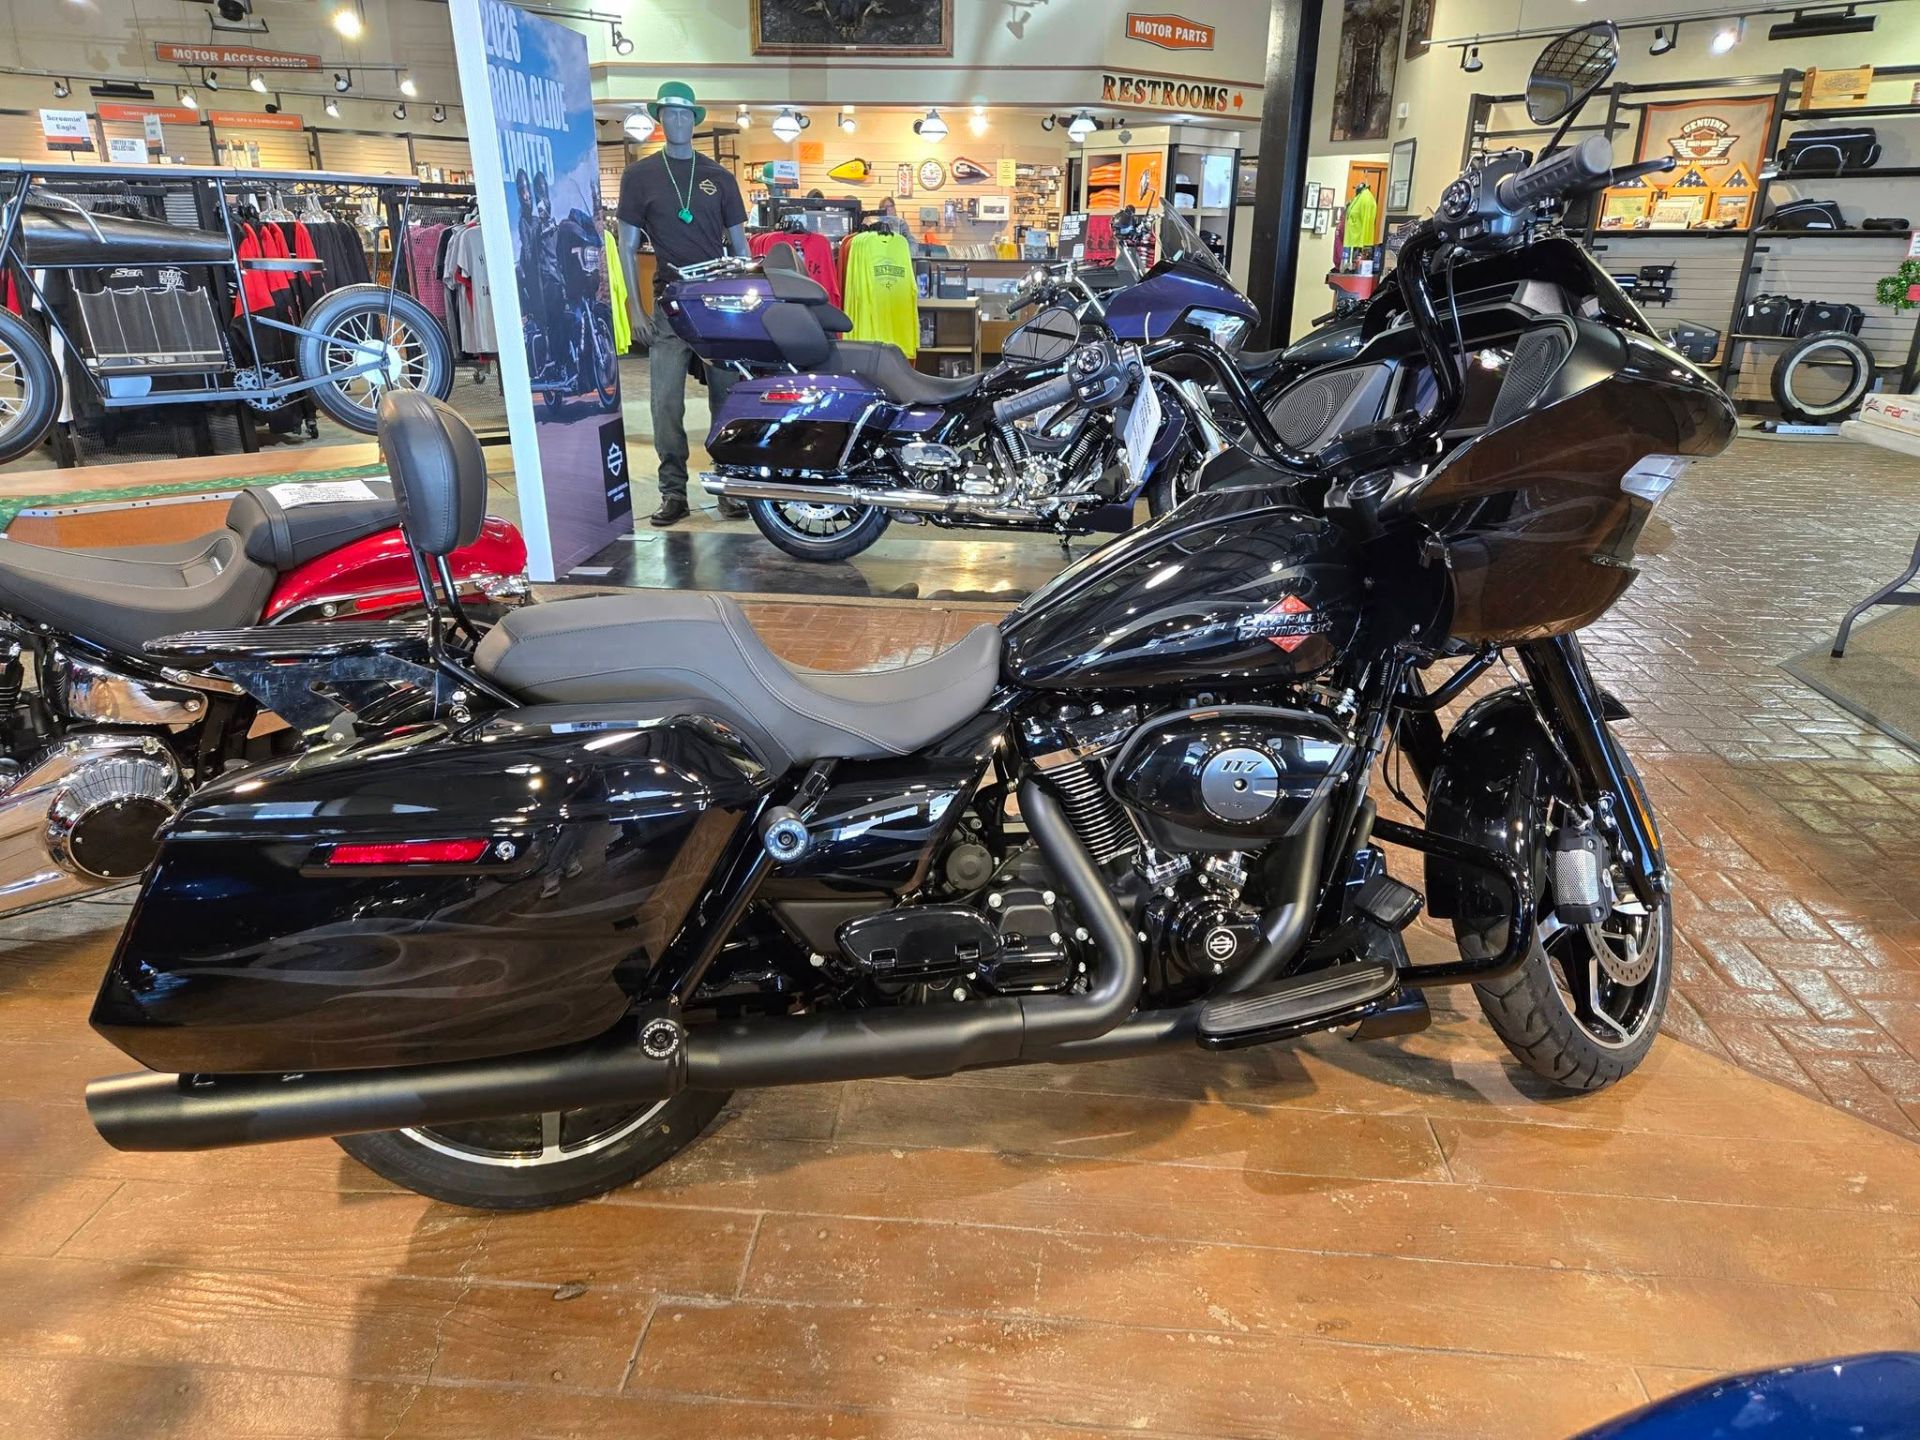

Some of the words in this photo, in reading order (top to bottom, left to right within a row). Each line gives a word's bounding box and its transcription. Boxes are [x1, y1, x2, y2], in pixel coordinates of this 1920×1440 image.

[479, 1, 522, 63] 2026
[1135, 20, 1172, 38] MOTOR
[1175, 27, 1208, 43] PARTS
[172, 48, 219, 62] MOTOR
[488, 64, 531, 125] ROAD
[529, 75, 570, 132] GLIDE
[1101, 75, 1229, 112] RESTROOMS
[1683, 118, 1728, 133] GENUINE
[497, 128, 555, 186] LIMITED
[1220, 759, 1263, 773] 117
